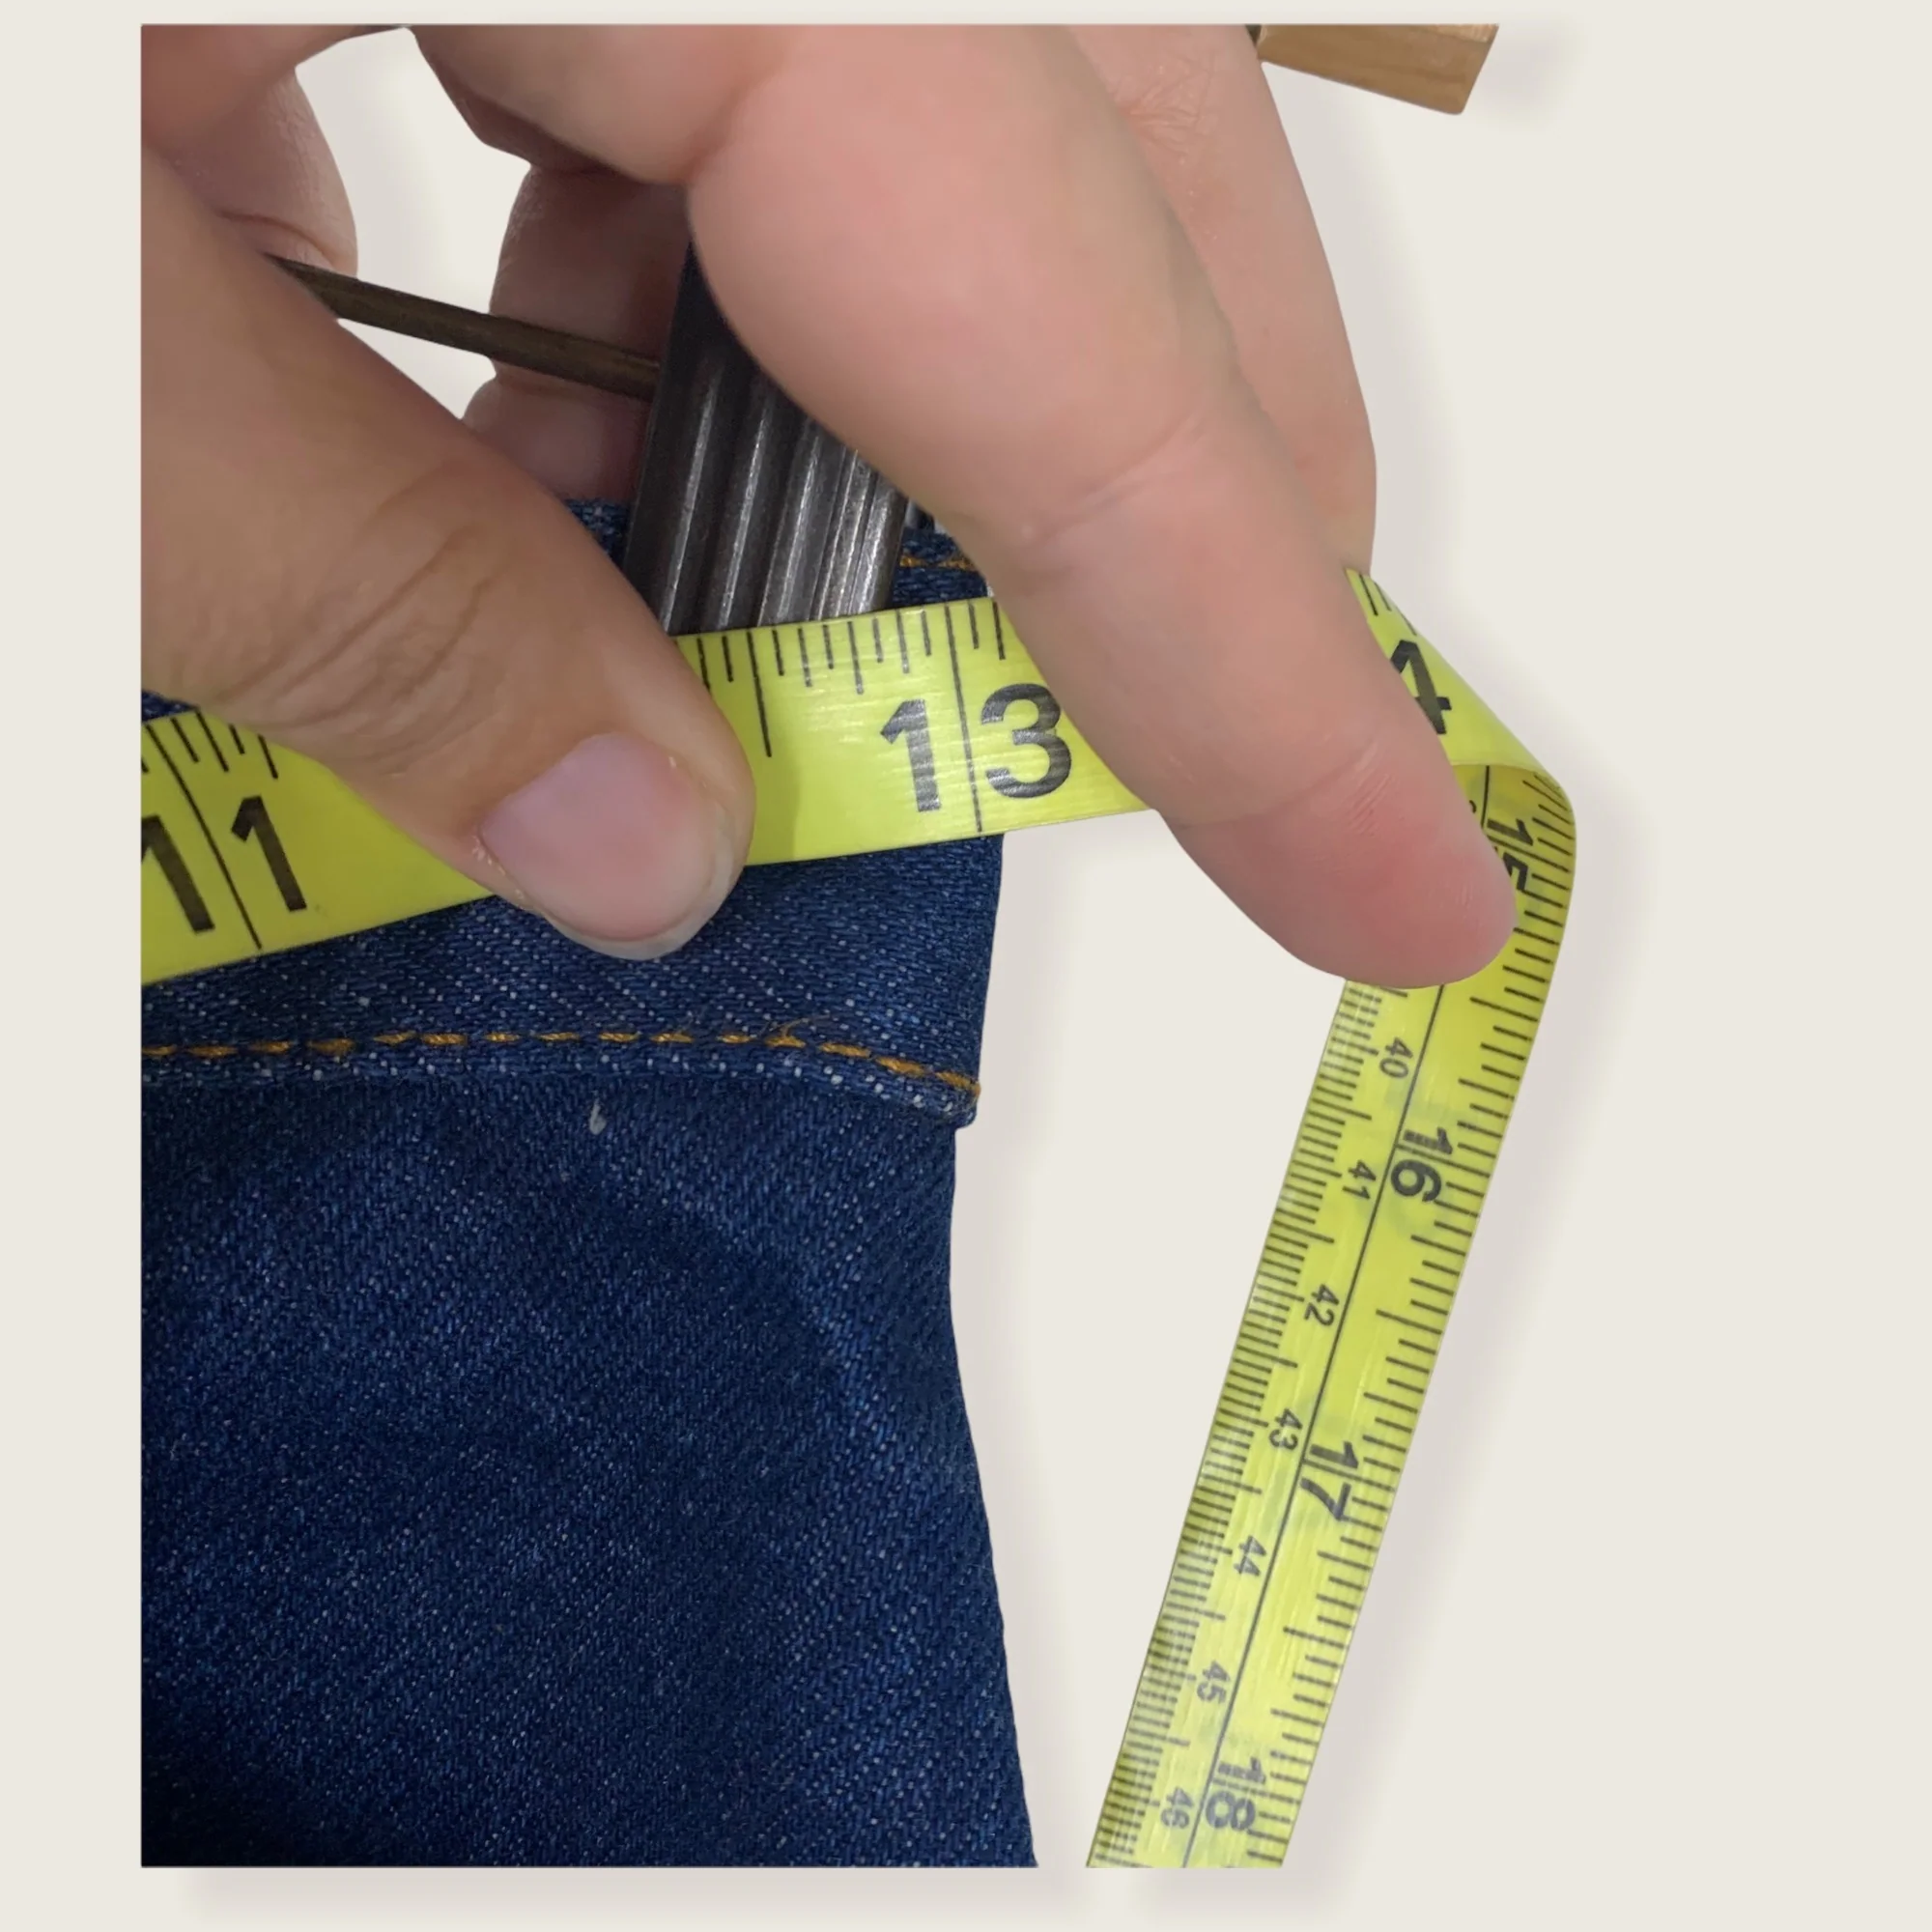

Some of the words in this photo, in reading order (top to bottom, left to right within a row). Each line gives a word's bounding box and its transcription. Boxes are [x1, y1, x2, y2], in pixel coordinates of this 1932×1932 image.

[880, 683, 1072, 811] 13
[1379, 1037, 1413, 1079] 40
[1342, 1160, 1377, 1201] 41
[1391, 1126, 1453, 1203] 16
[1304, 1284, 1340, 1327] 42
[1268, 1407, 1303, 1451] 43
[1300, 1441, 1359, 1521] 17
[1233, 1535, 1267, 1577] 44
[1196, 1660, 1231, 1704] 45
[1159, 1786, 1195, 1831] 46
[1205, 1756, 1266, 1832] 18
